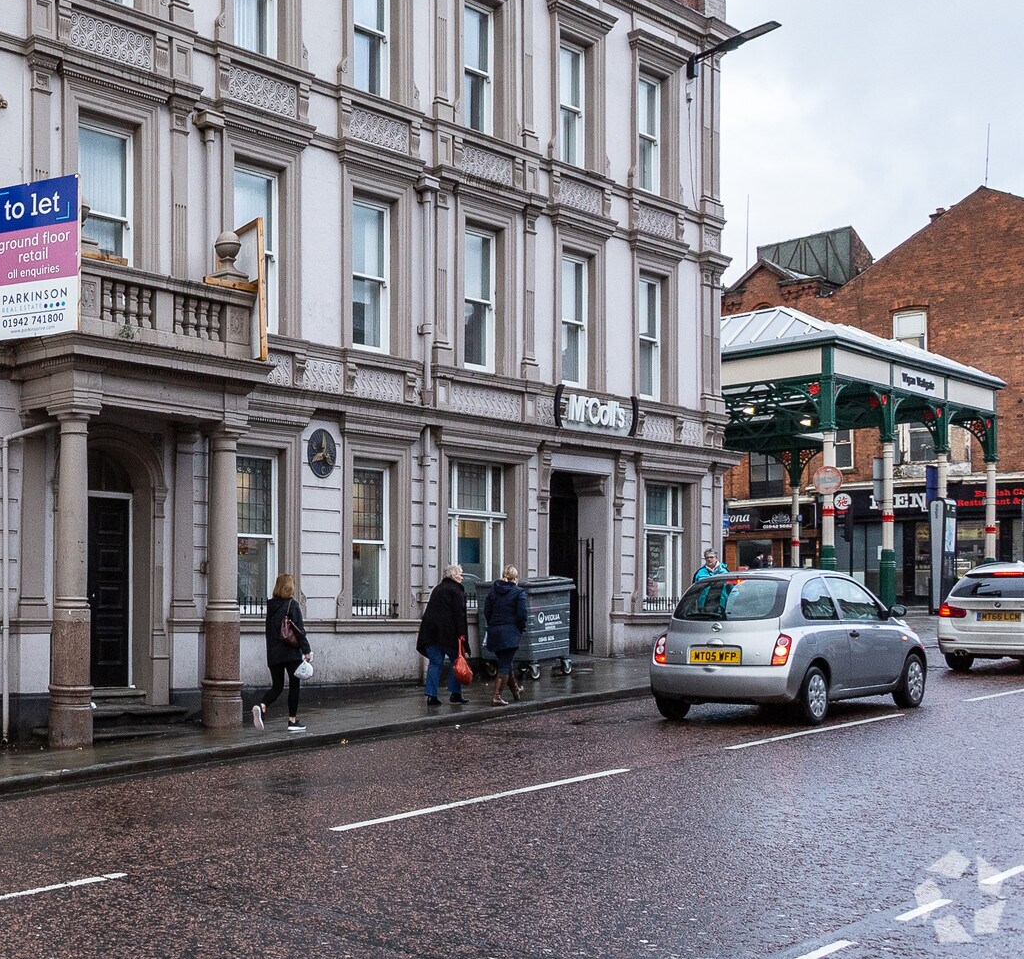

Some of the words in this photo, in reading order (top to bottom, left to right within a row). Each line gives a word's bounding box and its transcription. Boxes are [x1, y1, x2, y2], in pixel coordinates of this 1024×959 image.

[4, 200, 25, 221] to
[30, 191, 60, 216] let
[42, 231, 71, 245] floor
[18, 247, 48, 263] retail
[7, 268, 18, 279] all
[20, 264, 60, 278] enquiries
[2, 287, 68, 306] PARKINSON
[2, 306, 18, 314] REAL
[19, 303, 42, 312] ESTATE
[2, 317, 29, 329] 01942
[32, 312, 64, 325] 741800
[568, 394, 626, 429] McColl's
[694, 651, 717, 661] MT05
[719, 651, 737, 661] WFP
